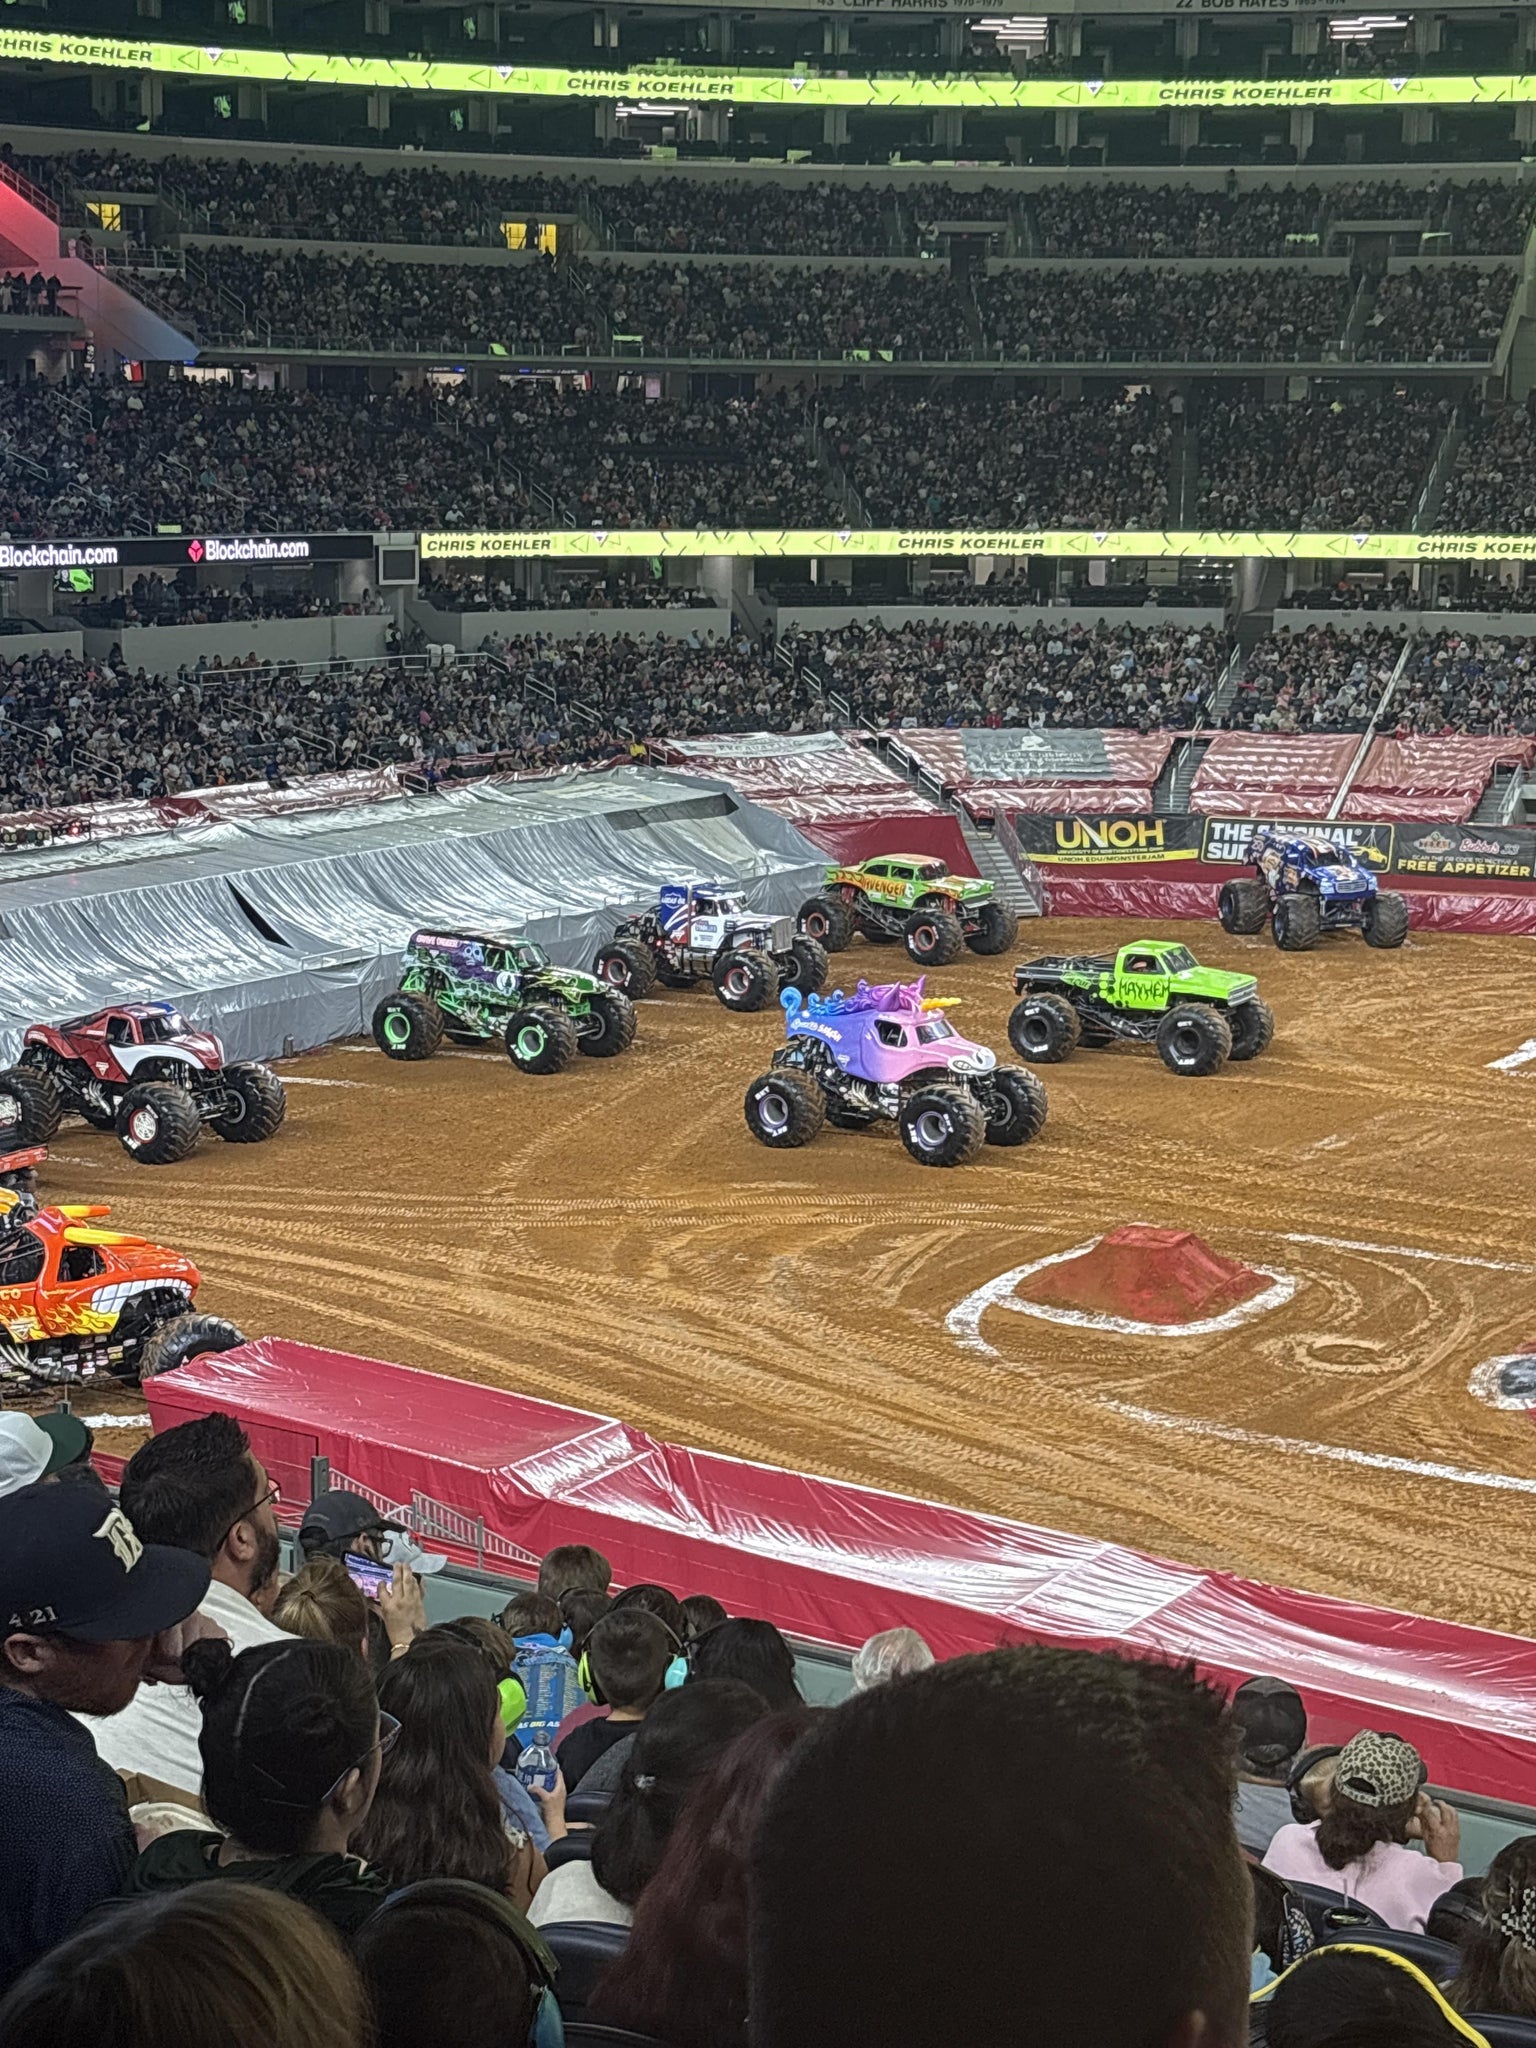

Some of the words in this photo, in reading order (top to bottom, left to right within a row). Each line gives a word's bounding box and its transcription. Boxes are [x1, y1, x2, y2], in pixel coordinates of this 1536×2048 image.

[59, 43, 153, 62] KOEHLER
[567, 77, 632, 91] CHRIS
[637, 81, 734, 95] KOEHLER
[1159, 88, 1226, 100] CHRIS
[1232, 87, 1332, 100] KOEHLER
[205, 538, 309, 561] Blockchain.com
[427, 539, 476, 551] CHRIS
[480, 539, 551, 551] KOEHLER
[898, 538, 955, 550] CHRIS
[960, 538, 1044, 550] KOEHLER
[1417, 541, 1478, 553] CHRIS
[1055, 818, 1164, 848] UNOH
[1211, 822, 1254, 842] THE
[1398, 858, 1437, 872] FREE
[1442, 862, 1531, 877] APPETIZER
[1119, 976, 1171, 1001] MAYHEM
